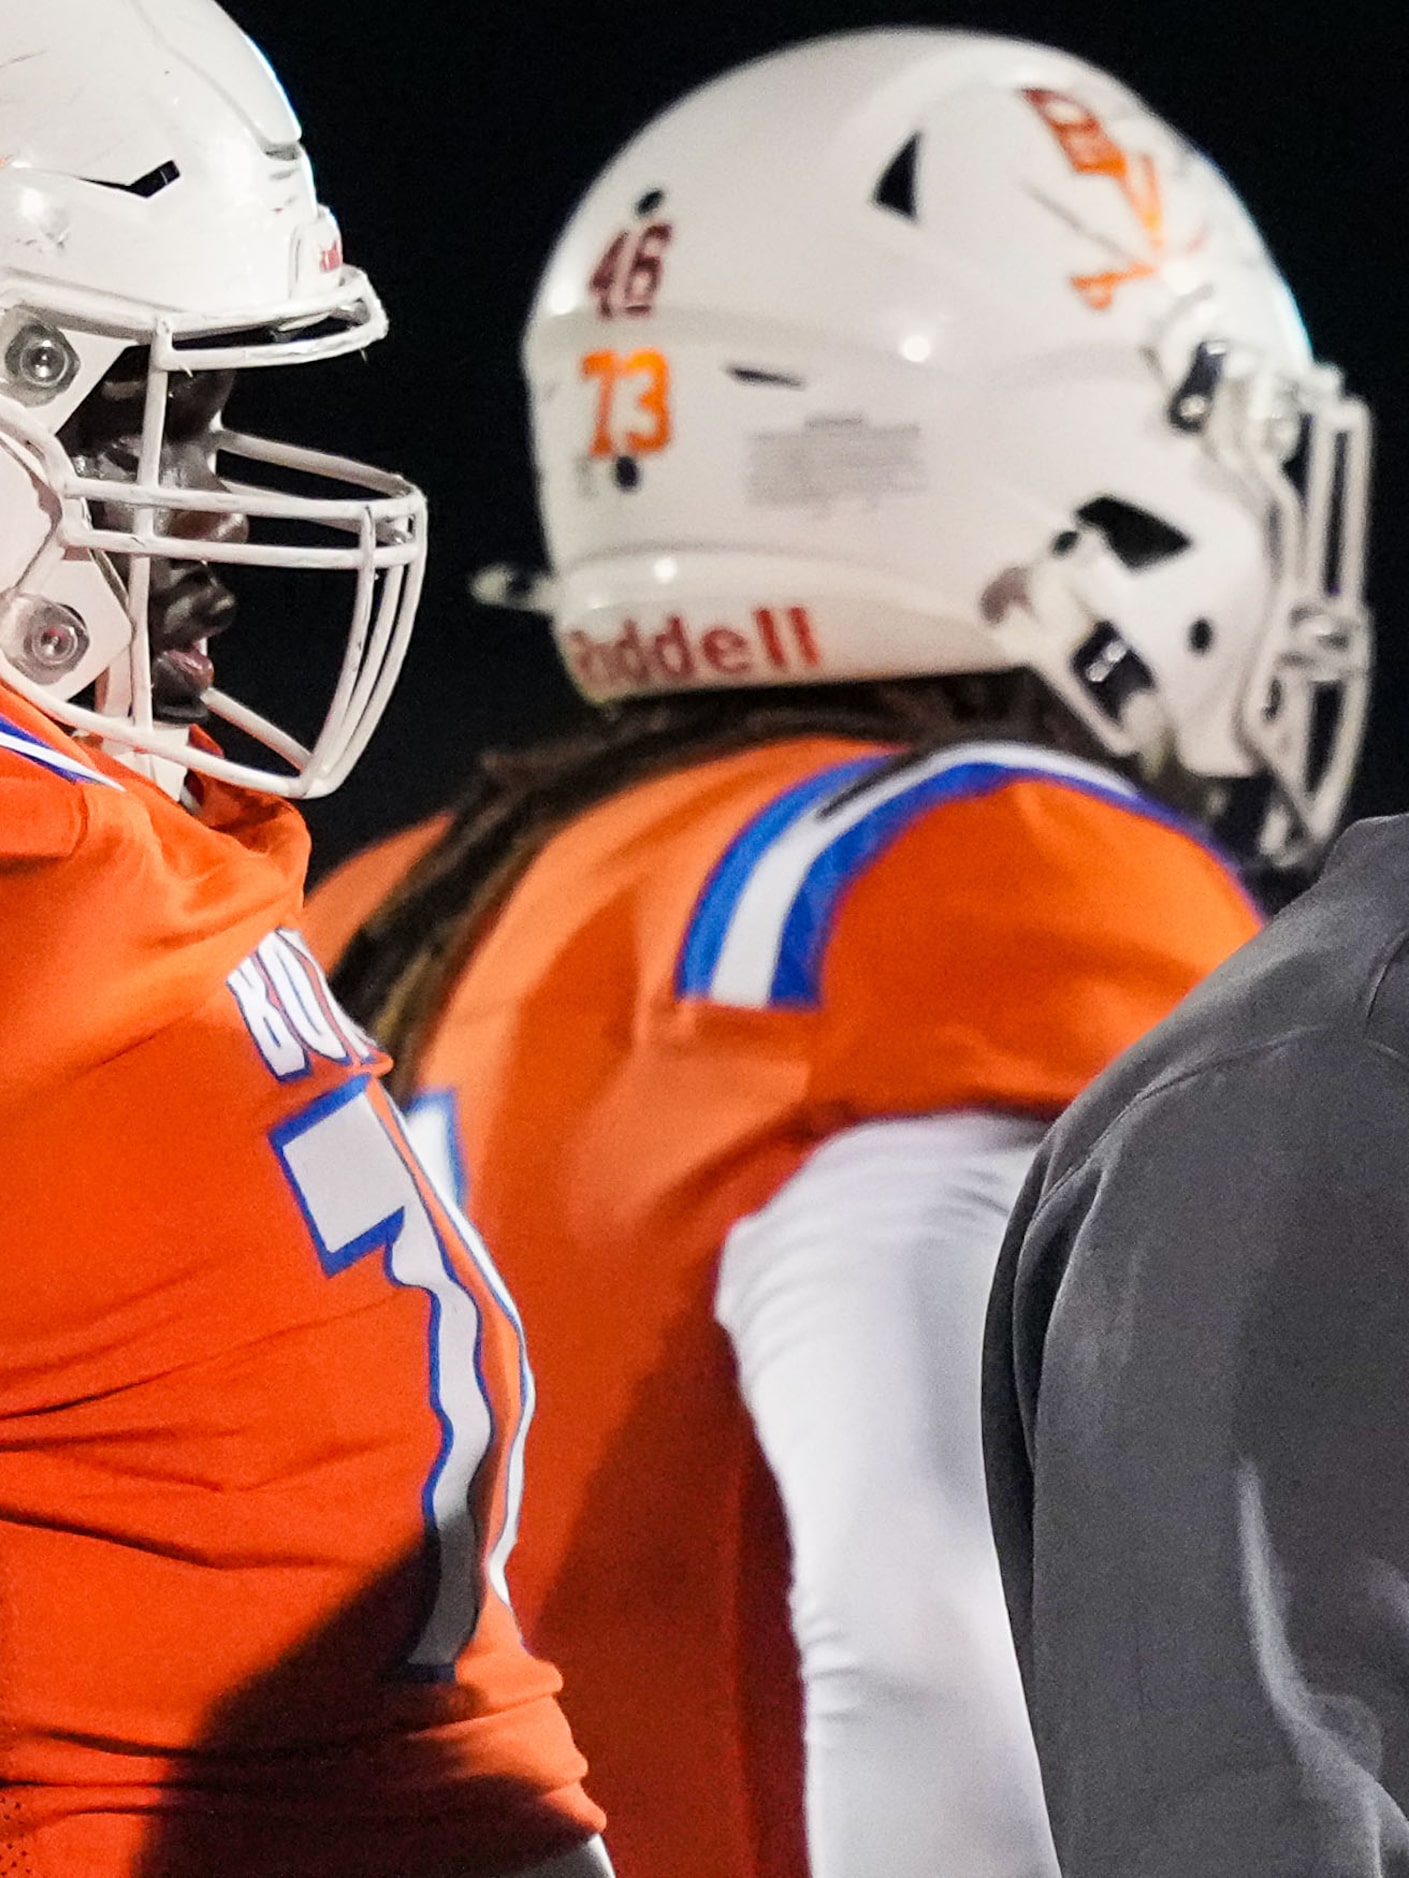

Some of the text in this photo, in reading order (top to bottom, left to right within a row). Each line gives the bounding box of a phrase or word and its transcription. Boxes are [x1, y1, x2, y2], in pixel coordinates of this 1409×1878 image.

[589, 222, 673, 318] 46
[580, 348, 672, 457] 73
[562, 606, 820, 690] iddell
[268, 1072, 537, 1683] 7
